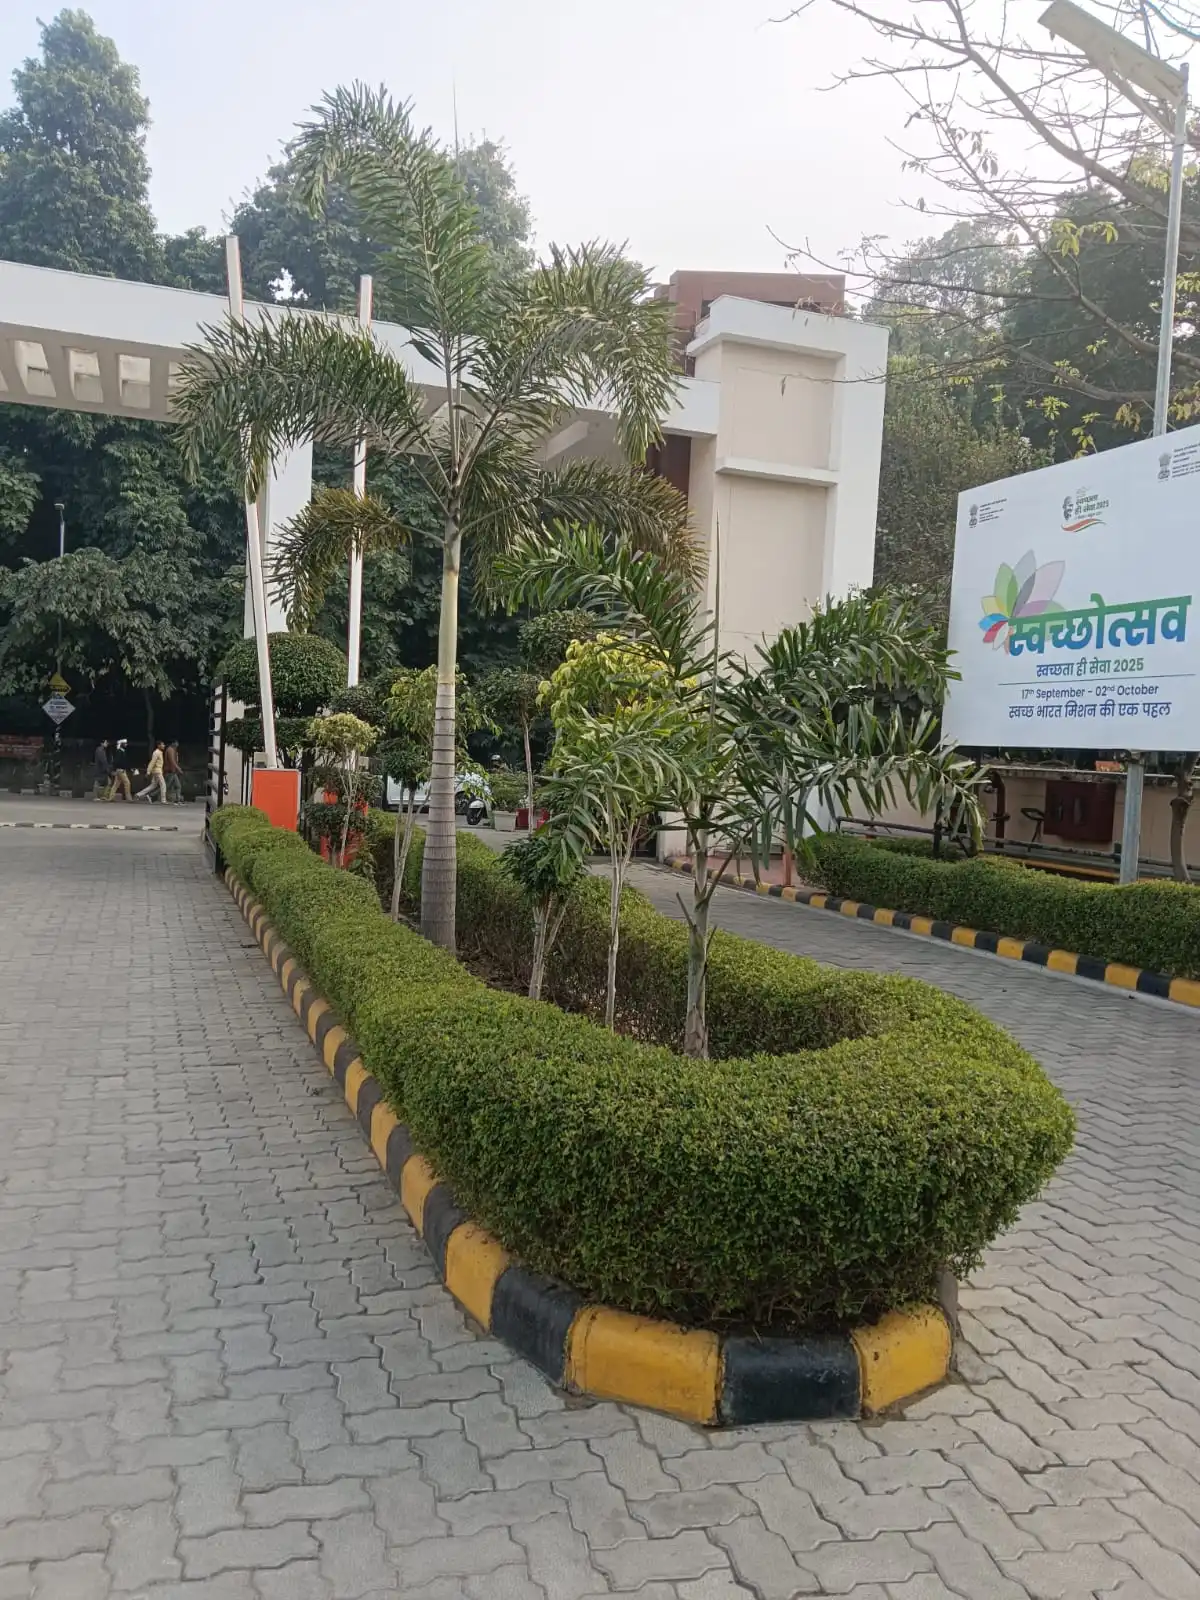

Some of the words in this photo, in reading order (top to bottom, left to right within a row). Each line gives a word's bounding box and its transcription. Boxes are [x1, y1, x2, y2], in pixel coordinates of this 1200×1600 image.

[1008, 593, 1192, 656] स्वच्छोत्सव
[1036, 662, 1074, 678] स्वच्छता
[1076, 657, 1087, 677] ही
[1089, 657, 1111, 675] सेवा
[1113, 657, 1144, 672] 2025
[1021, 689, 1035, 700] 17th
[1036, 687, 1085, 701] September
[1095, 685, 1115, 697] 02nd
[1117, 684, 1159, 696] October
[1009, 705, 1034, 719] स्वच्छ
[1036, 704, 1062, 718] भारत
[1065, 700, 1097, 718] मिशन
[1099, 699, 1115, 718] की
[1118, 702, 1139, 717] एक
[1142, 701, 1172, 719] पहल
